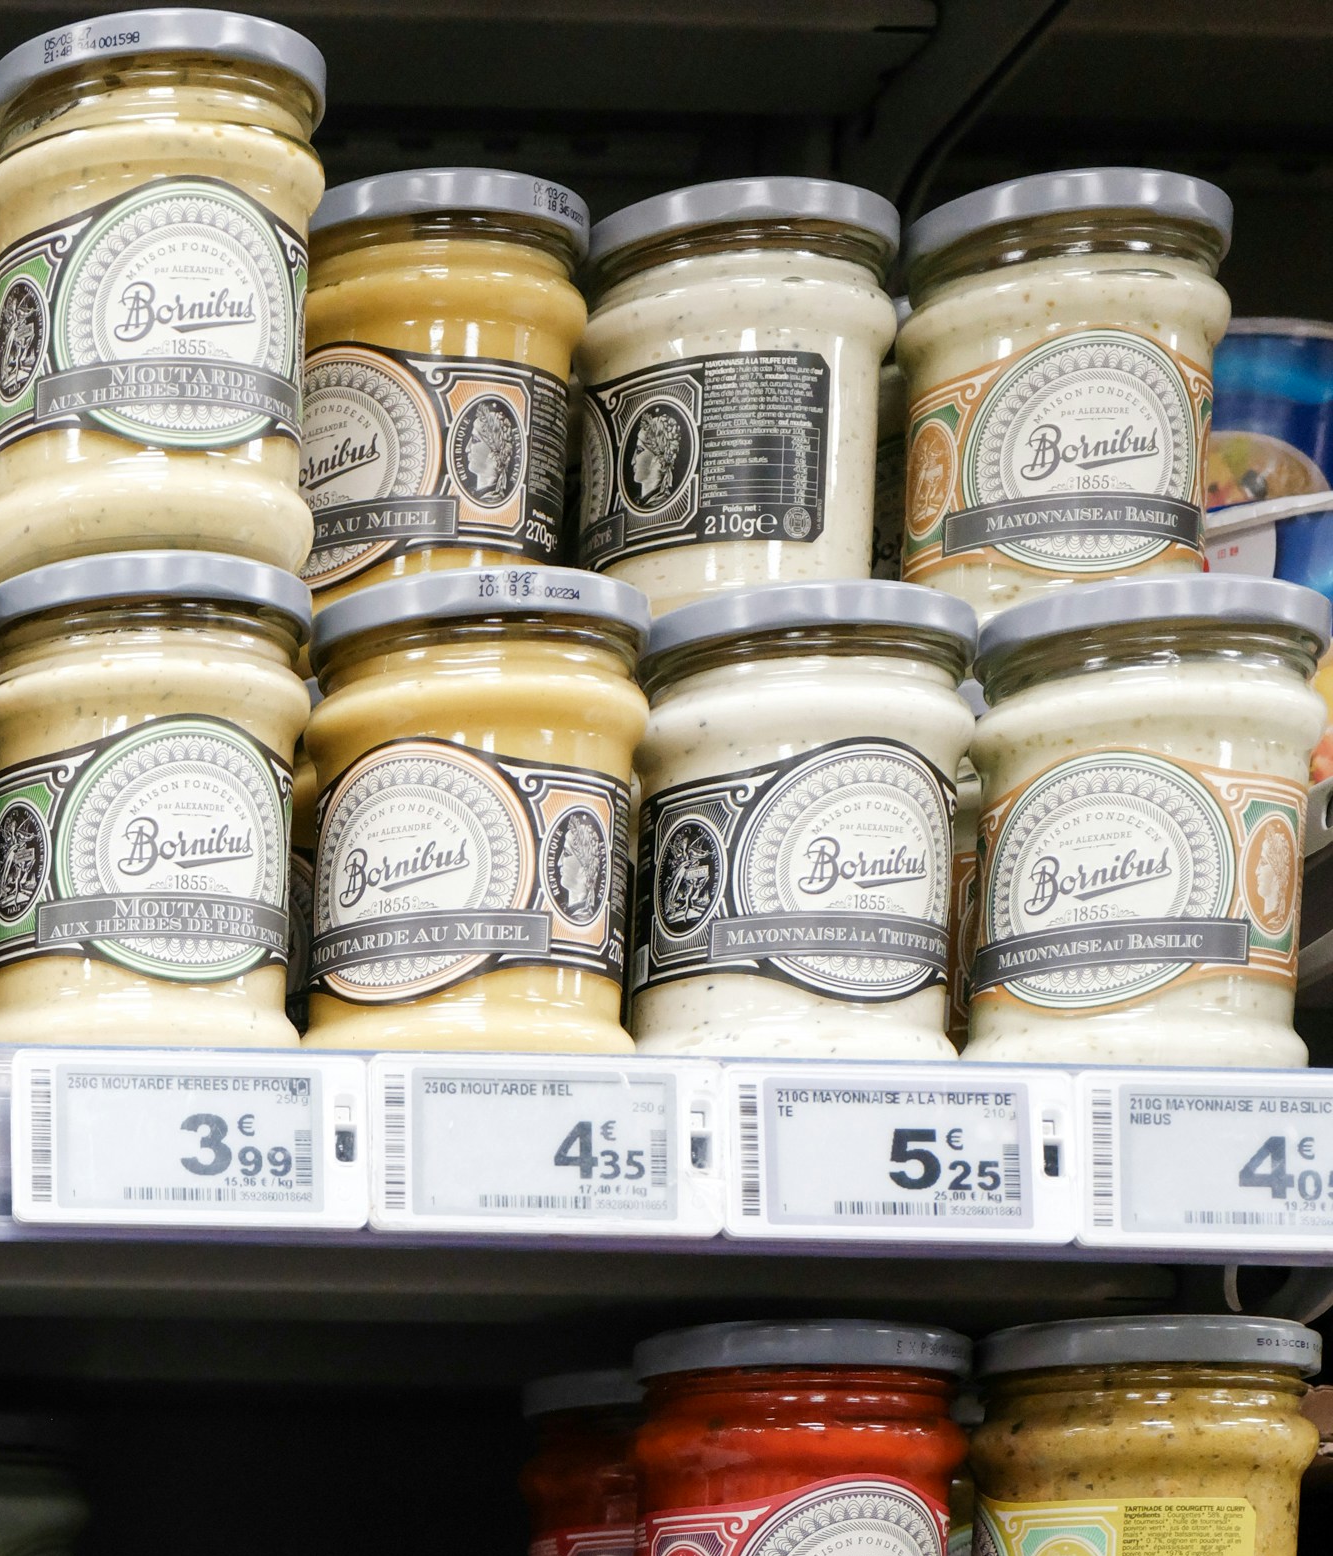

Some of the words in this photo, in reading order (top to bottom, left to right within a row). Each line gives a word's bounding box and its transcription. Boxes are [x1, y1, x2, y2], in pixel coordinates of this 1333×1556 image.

[114, 281, 257, 342] Bornibus
[109, 366, 257, 388] MOUTARDE
[49, 396, 81, 412] AUX
[91, 382, 178, 404] HERBES
[184, 382, 210, 399] DE
[213, 384, 294, 418] PROVENCE
[1021, 427, 1159, 480] Bornibus
[986, 508, 1099, 532] MAYONNAISE
[1104, 509, 1123, 520] AU
[1125, 504, 1178, 528] BASILIC
[339, 843, 470, 906] Bornibus
[777, 1090, 809, 1104] 210G
[812, 1092, 900, 1105] MAYONNAISE
[937, 1094, 987, 1107] TRUFFE
[992, 1095, 1011, 1106] DE
[777, 1106, 793, 1118] TE
